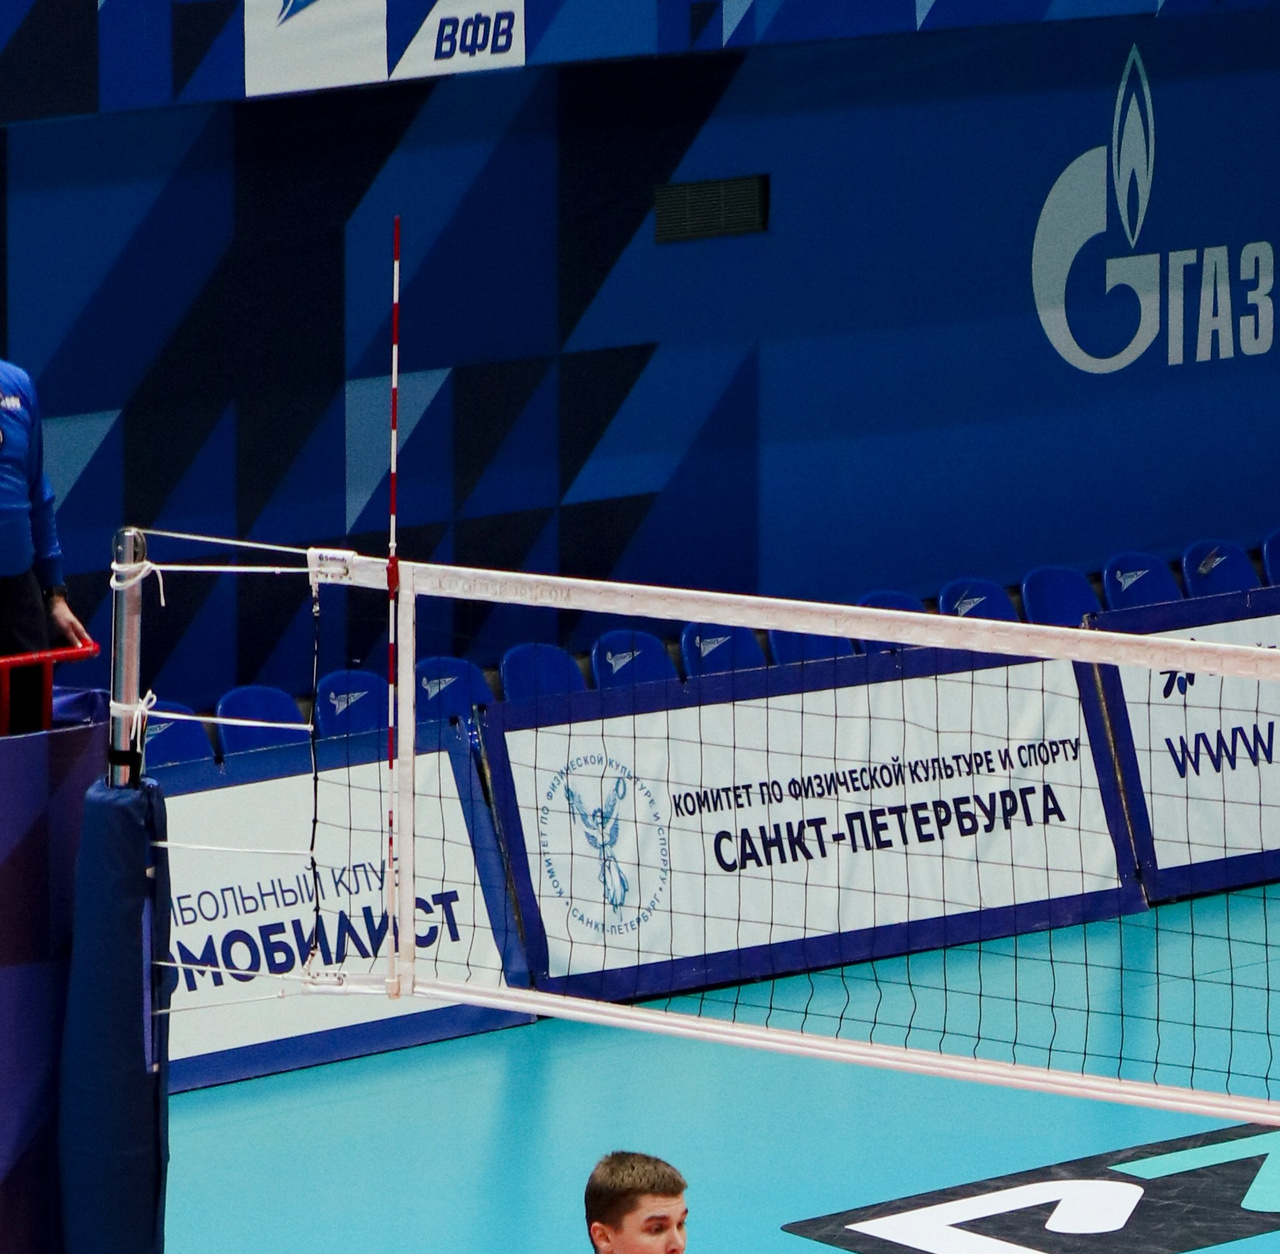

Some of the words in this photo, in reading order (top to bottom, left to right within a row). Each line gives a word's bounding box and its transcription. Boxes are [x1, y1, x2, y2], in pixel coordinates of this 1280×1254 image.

[434, 10, 516, 62] ВФВ
[672, 783, 752, 817] КОМИТЕТ
[759, 780, 784, 805] ПО
[788, 756, 906, 800] ФИЗИЧЕСКОЙ
[907, 754, 995, 785] КУЛЬТУРЕ
[998, 748, 1014, 771] И
[1017, 737, 1081, 769] СПОРТУ
[540, 805, 550, 825] ПО
[713, 784, 1067, 872] САНКТ-ПЕТЕРБУРГА
[540, 830, 564, 897] КОМИТЕТ
